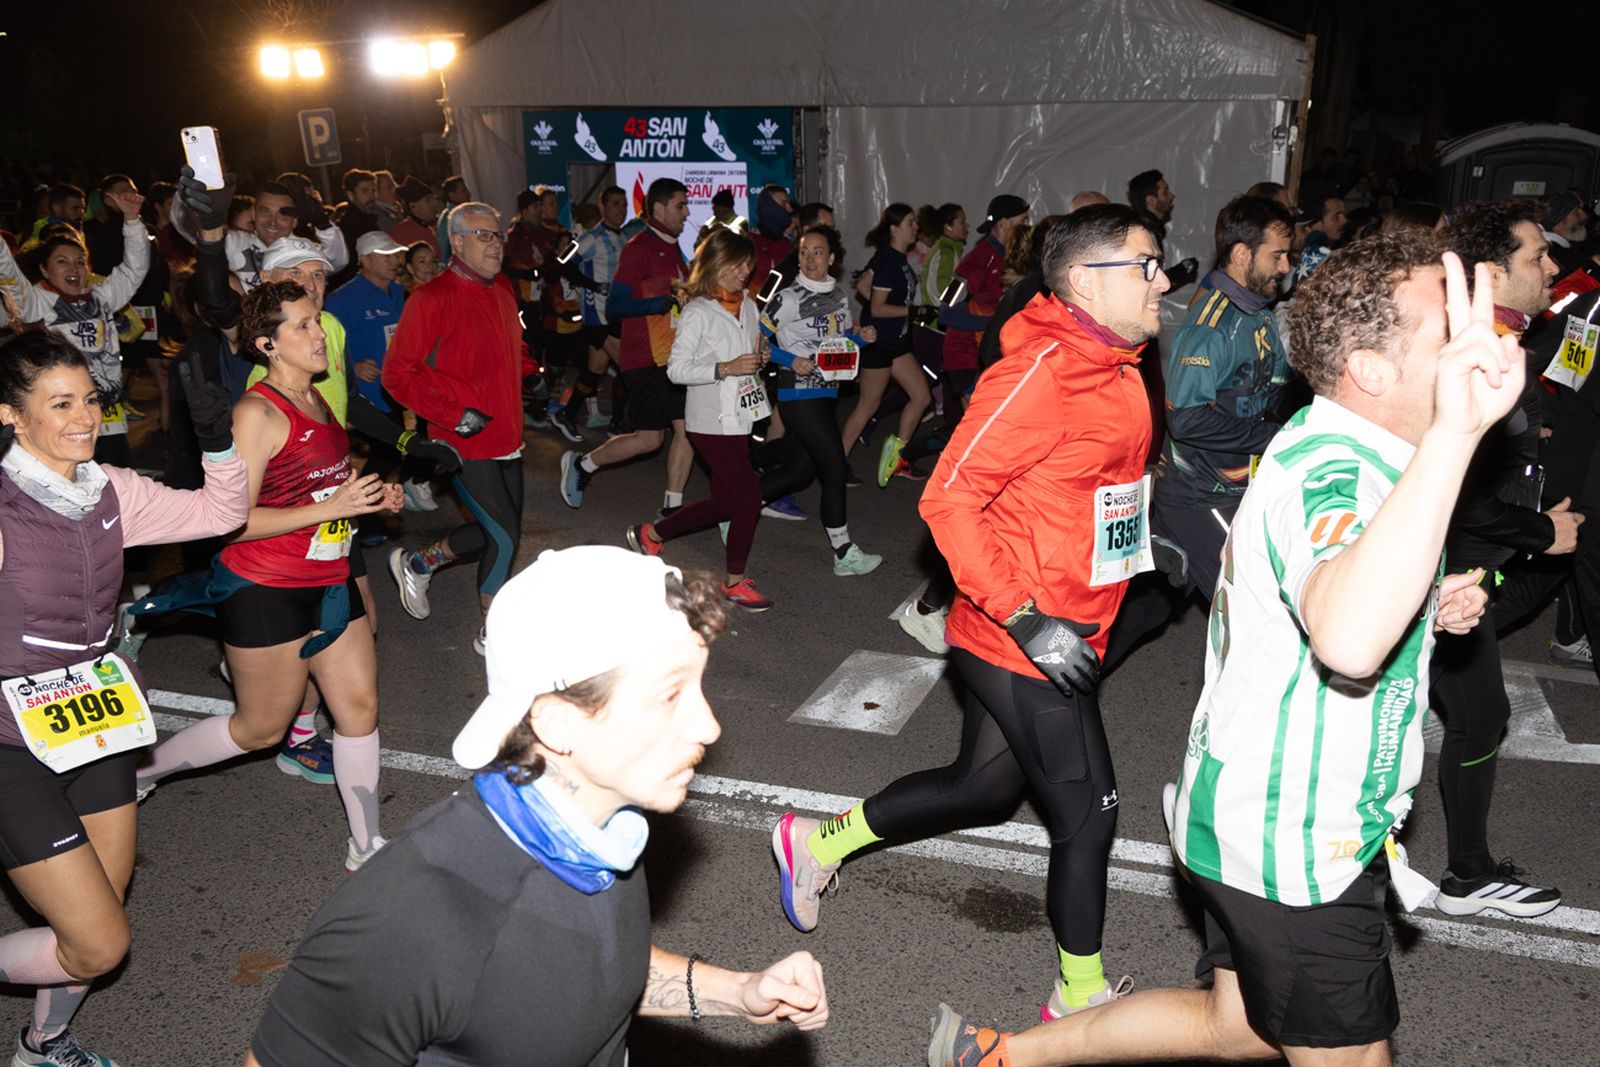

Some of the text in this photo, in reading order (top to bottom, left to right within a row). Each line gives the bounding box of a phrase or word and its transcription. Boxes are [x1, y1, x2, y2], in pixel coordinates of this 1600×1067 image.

[624, 116, 688, 138] 43 SAN
[619, 133, 686, 158] ANTÓN
[712, 138, 725, 153] 43
[686, 184, 713, 198] SAN
[740, 388, 765, 409] 4735
[1104, 508, 1119, 520] SAN
[26, 693, 51, 709] SAN
[54, 682, 92, 701] ANTÓN
[35, 680, 71, 693] NOCHE
[44, 689, 124, 734] 3196
[1384, 677, 1415, 767] HUMANIDAD
[79, 722, 110, 737] manuela
[1373, 687, 1400, 768] PATRIMONIO
